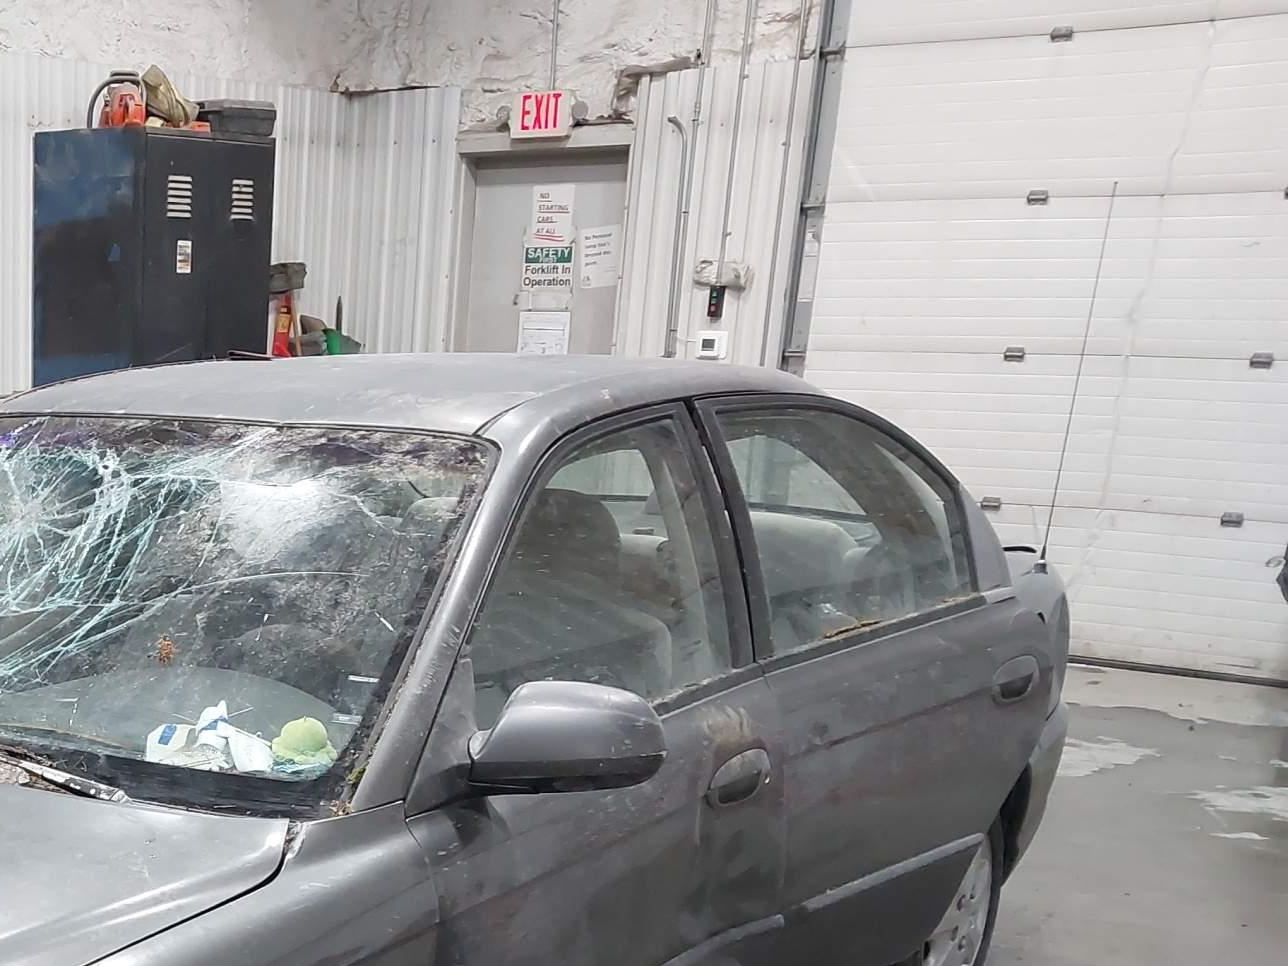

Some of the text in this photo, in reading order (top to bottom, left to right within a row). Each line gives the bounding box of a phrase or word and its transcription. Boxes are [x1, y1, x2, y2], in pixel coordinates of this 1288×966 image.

[521, 93, 562, 130] EXIT
[527, 247, 571, 258] SAFETY
[524, 264, 571, 275] Forklift In
[523, 276, 571, 289] Operation
